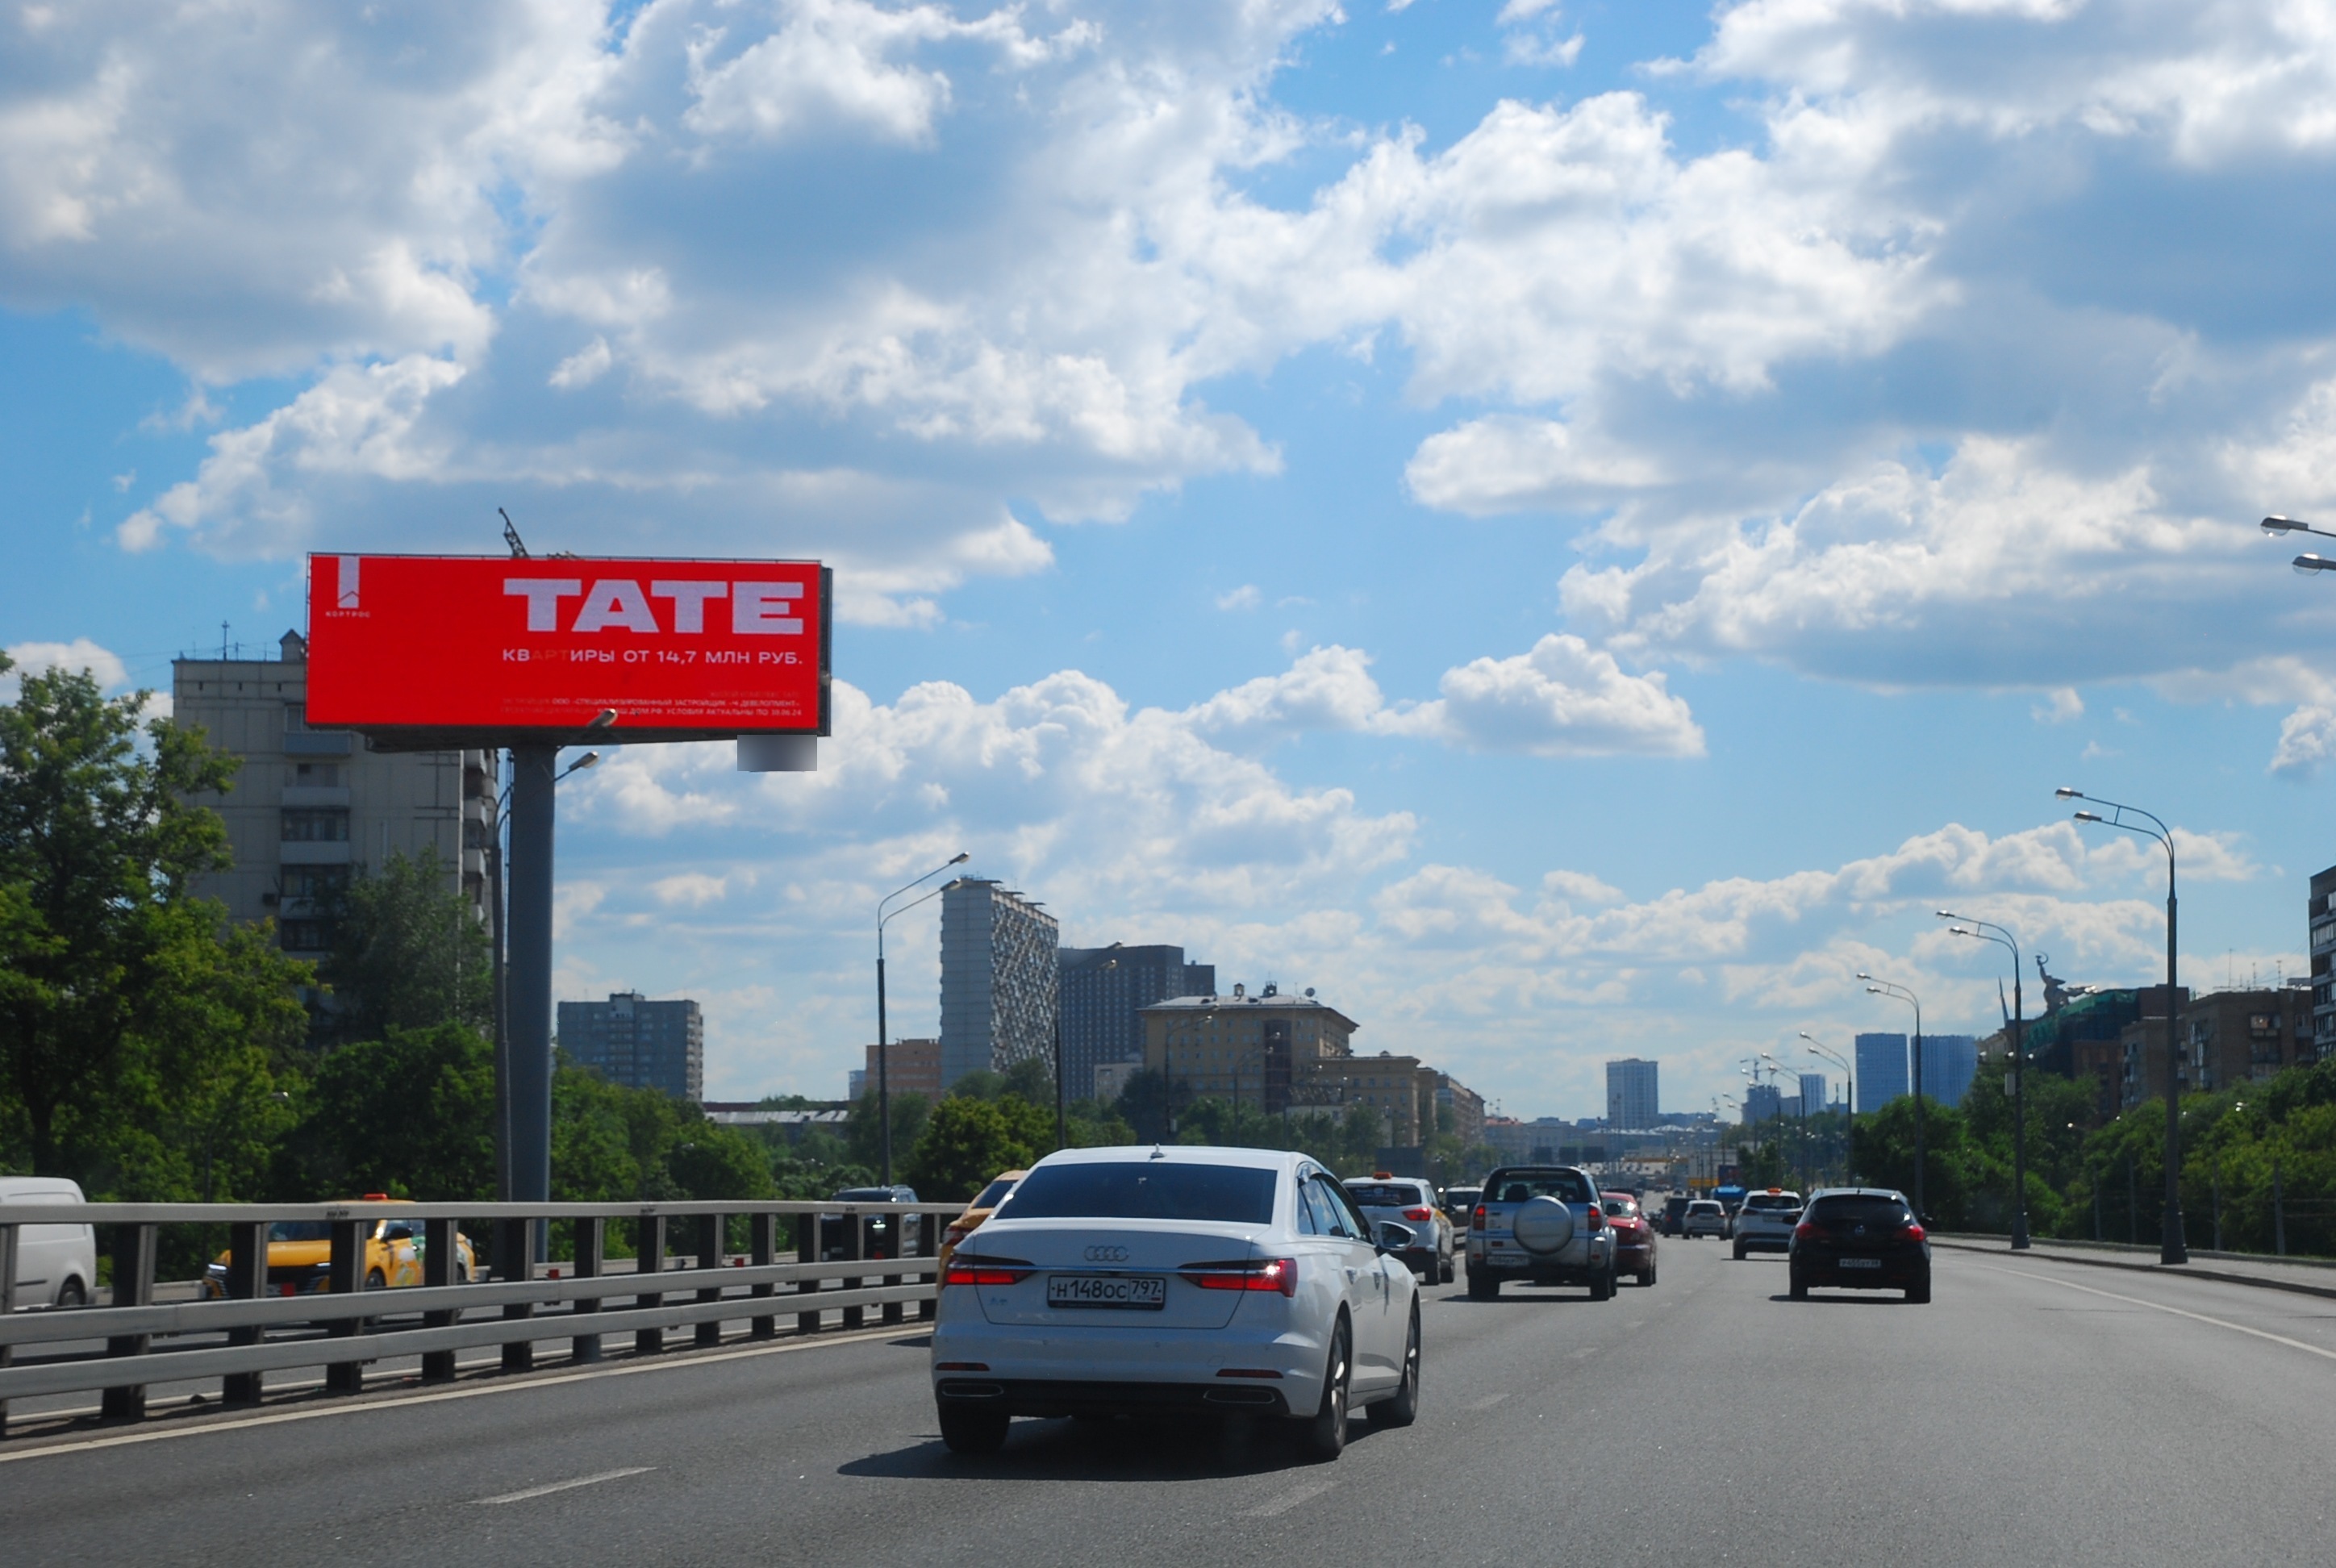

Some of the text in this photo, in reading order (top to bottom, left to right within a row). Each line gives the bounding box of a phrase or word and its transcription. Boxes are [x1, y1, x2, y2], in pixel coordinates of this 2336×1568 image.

[503, 578, 804, 635] TATE
[623, 649, 650, 663] ОТ
[657, 650, 697, 665] 14,7
[705, 651, 750, 664] МЛН
[758, 651, 803, 665] РУБ.
